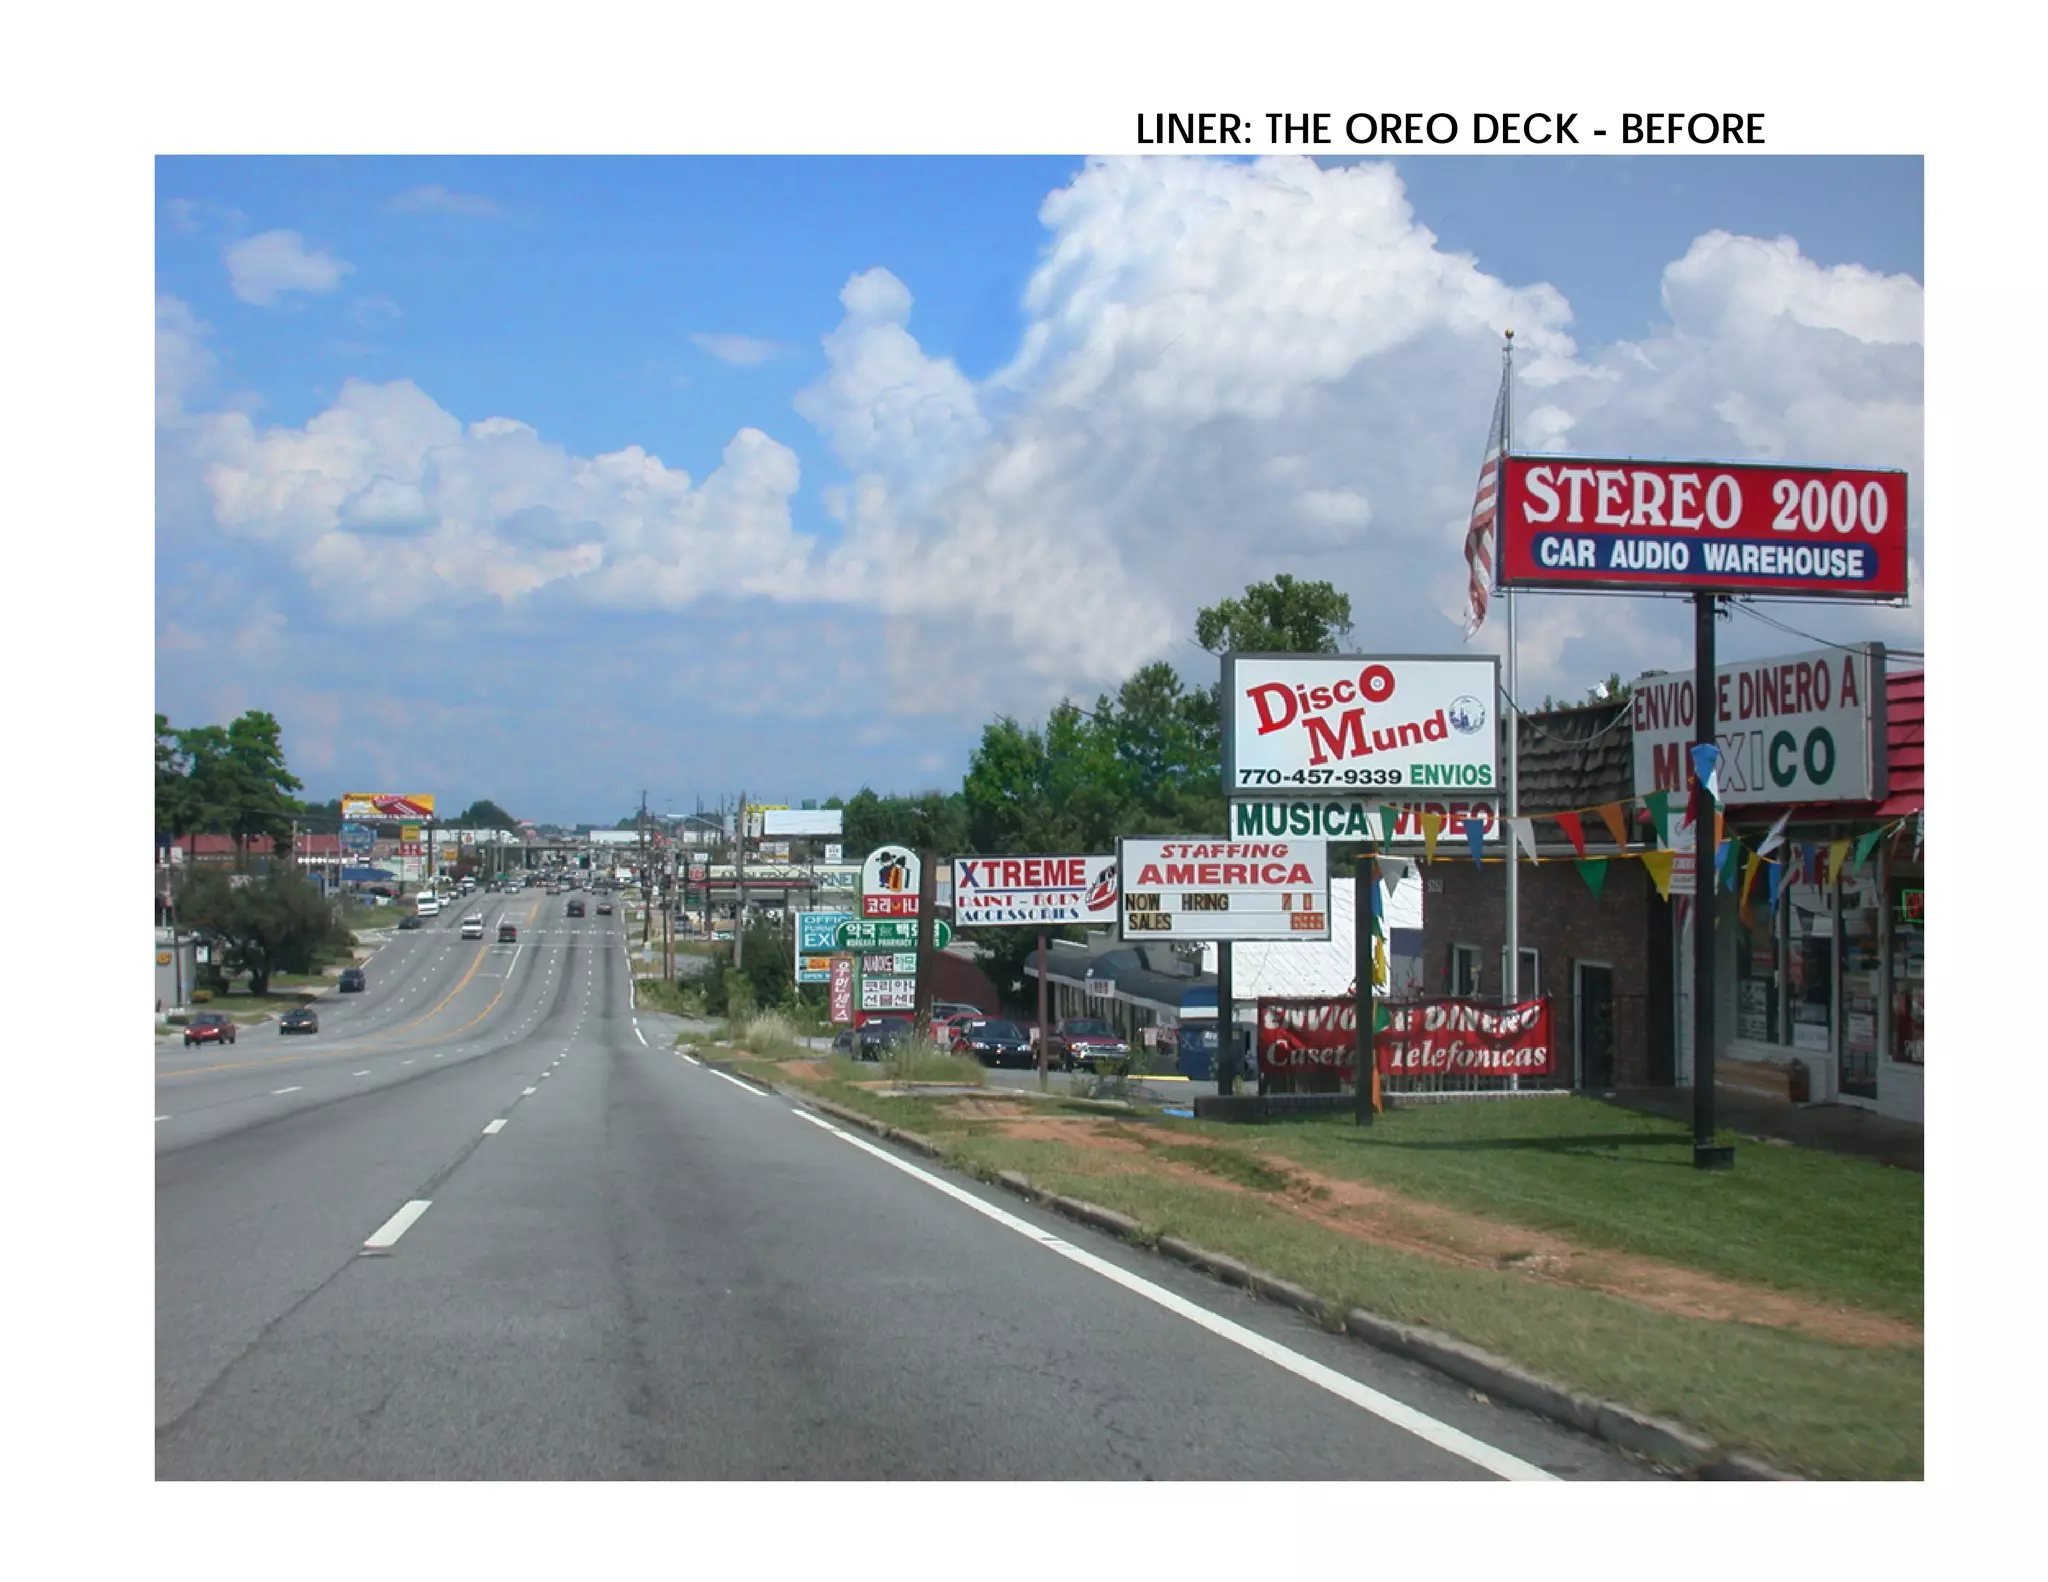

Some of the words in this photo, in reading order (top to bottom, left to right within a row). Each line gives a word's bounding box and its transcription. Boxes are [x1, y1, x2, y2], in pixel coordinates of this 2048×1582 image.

[1523, 466, 1744, 530] STEREO
[1772, 479, 1888, 534] 2000
[1540, 537, 1596, 568] CAR
[1609, 540, 1690, 571] AUDIO
[1702, 543, 1865, 578] WAREHOUSE
[1634, 680, 1694, 732] ENVIO
[1738, 659, 1832, 721] DINERO
[1840, 655, 1859, 708] A
[1238, 768, 1403, 785] 770-457-9339
[1410, 764, 1492, 785] ENVIOS
[1237, 802, 1370, 837] MUSICA
[1160, 843, 1289, 859] STAFFING
[958, 859, 1086, 888] XTREME
[1137, 863, 1314, 885] AMERICA
[958, 894, 1014, 908] PAINT
[1033, 893, 1081, 907] BODY
[1125, 893, 1161, 911] NOW
[963, 907, 1080, 921] ACCESSORIES
[1128, 913, 1172, 930] SALES
[1423, 1004, 1542, 1035] DINERO
[1389, 1039, 1547, 1074] Telefonicas
